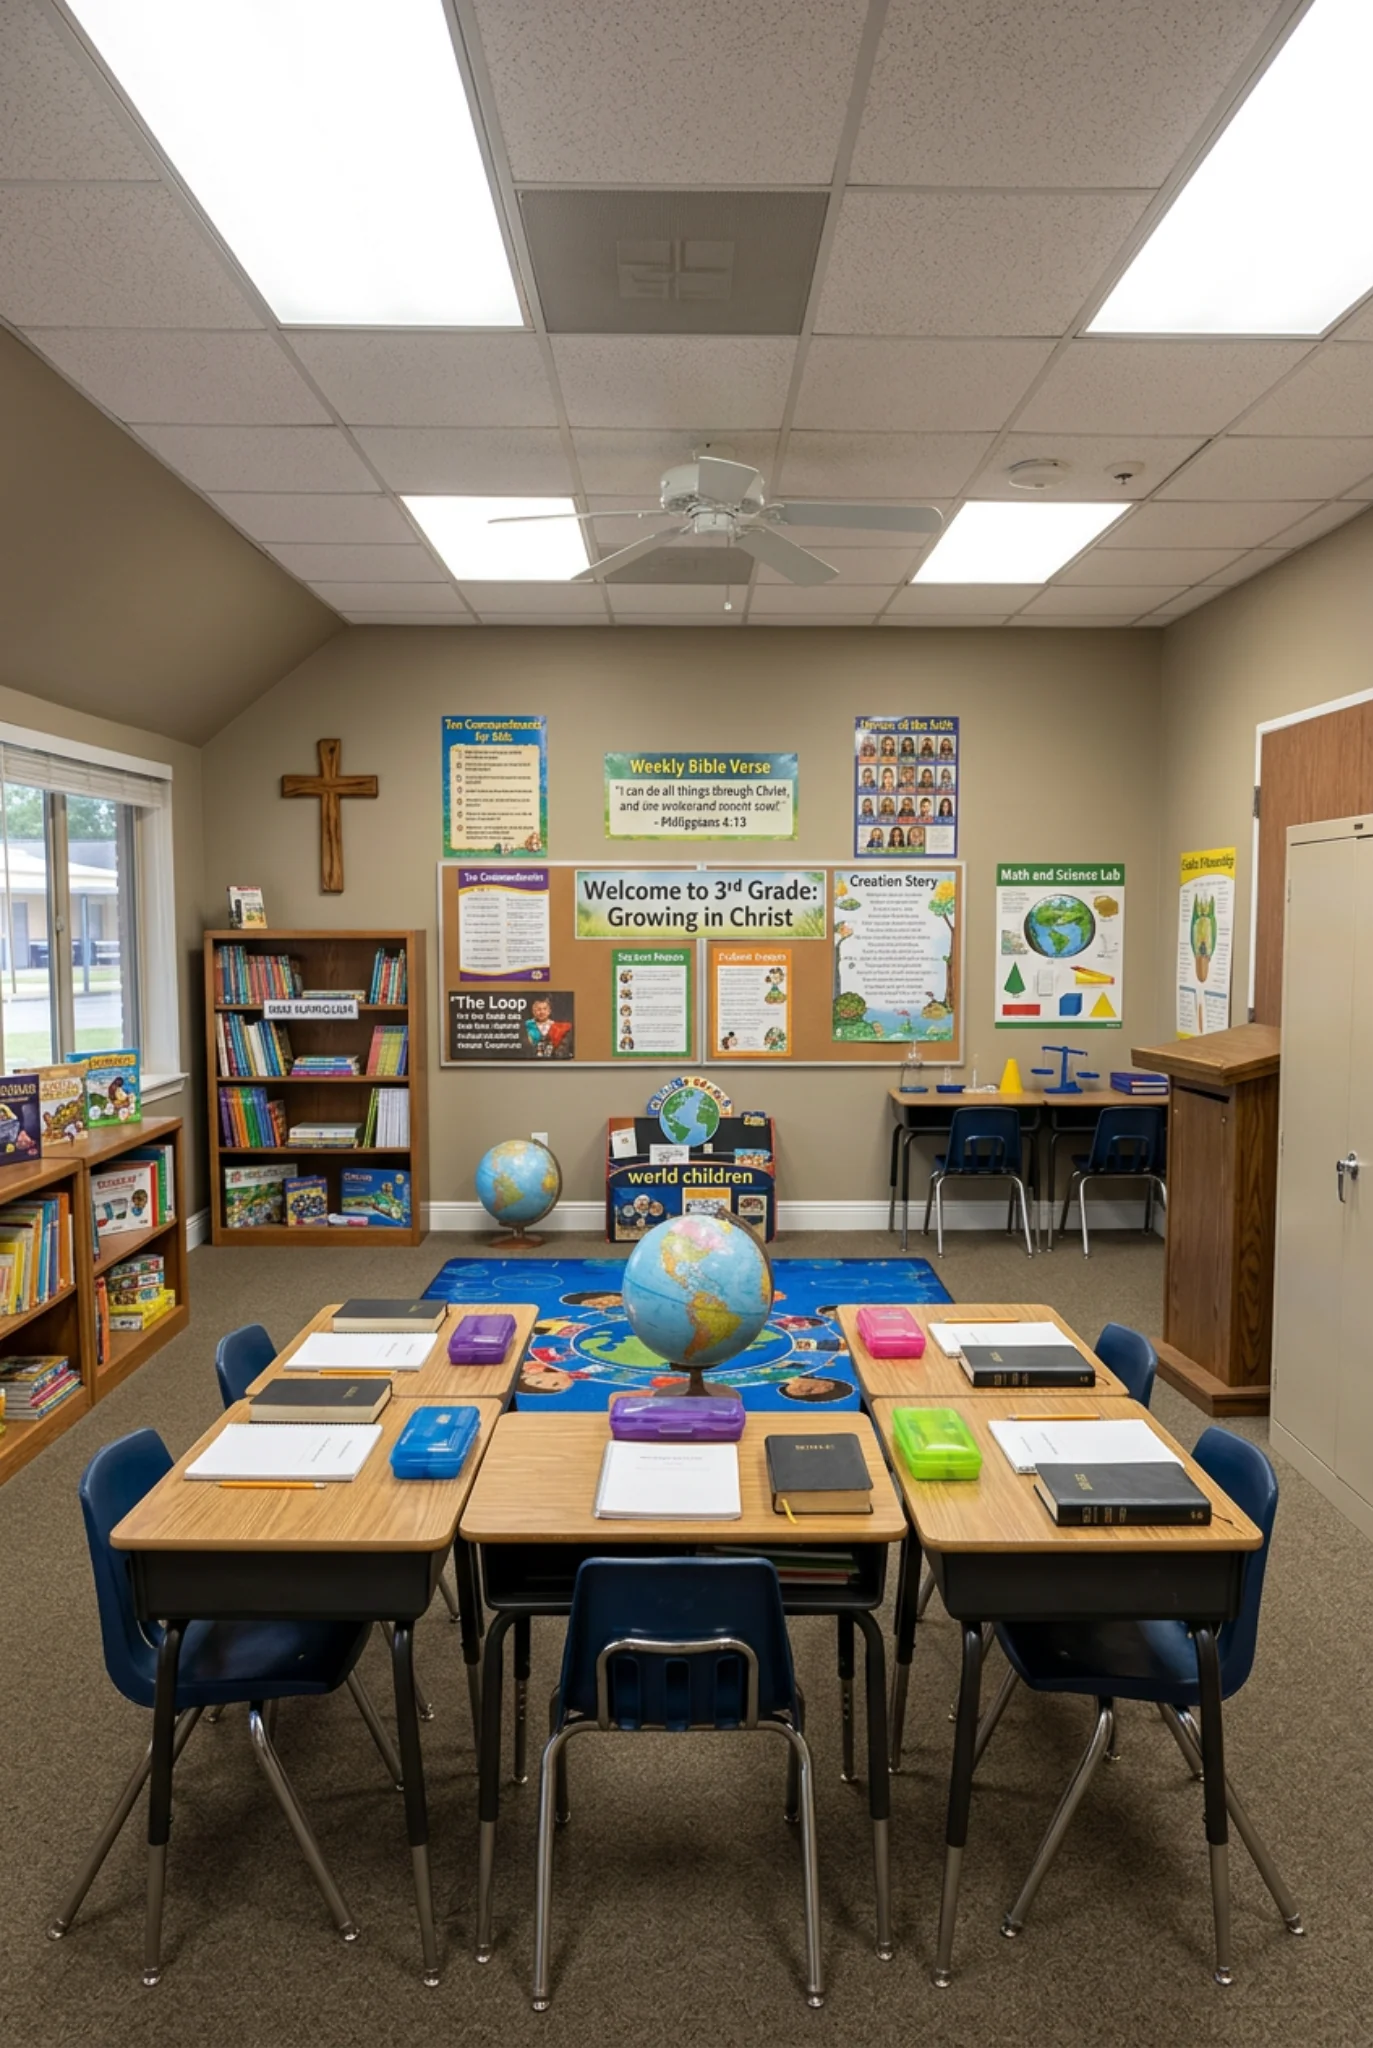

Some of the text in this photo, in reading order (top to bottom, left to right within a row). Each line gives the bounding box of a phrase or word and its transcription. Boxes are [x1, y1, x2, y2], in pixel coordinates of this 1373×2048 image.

[630, 759, 771, 777] Weekly Bible Verse
[626, 787, 644, 797] can
[662, 785, 675, 797] all
[678, 785, 709, 799] things
[620, 801, 639, 811] and
[722, 817, 747, 828] 4:13
[1001, 868, 1030, 881] Math
[1100, 869, 1121, 881] Lab
[584, 878, 818, 900] Welcome to 3rd Grade:
[607, 905, 793, 932] Growing in Christ
[488, 995, 528, 1012] Loop
[683, 1168, 753, 1184] children
